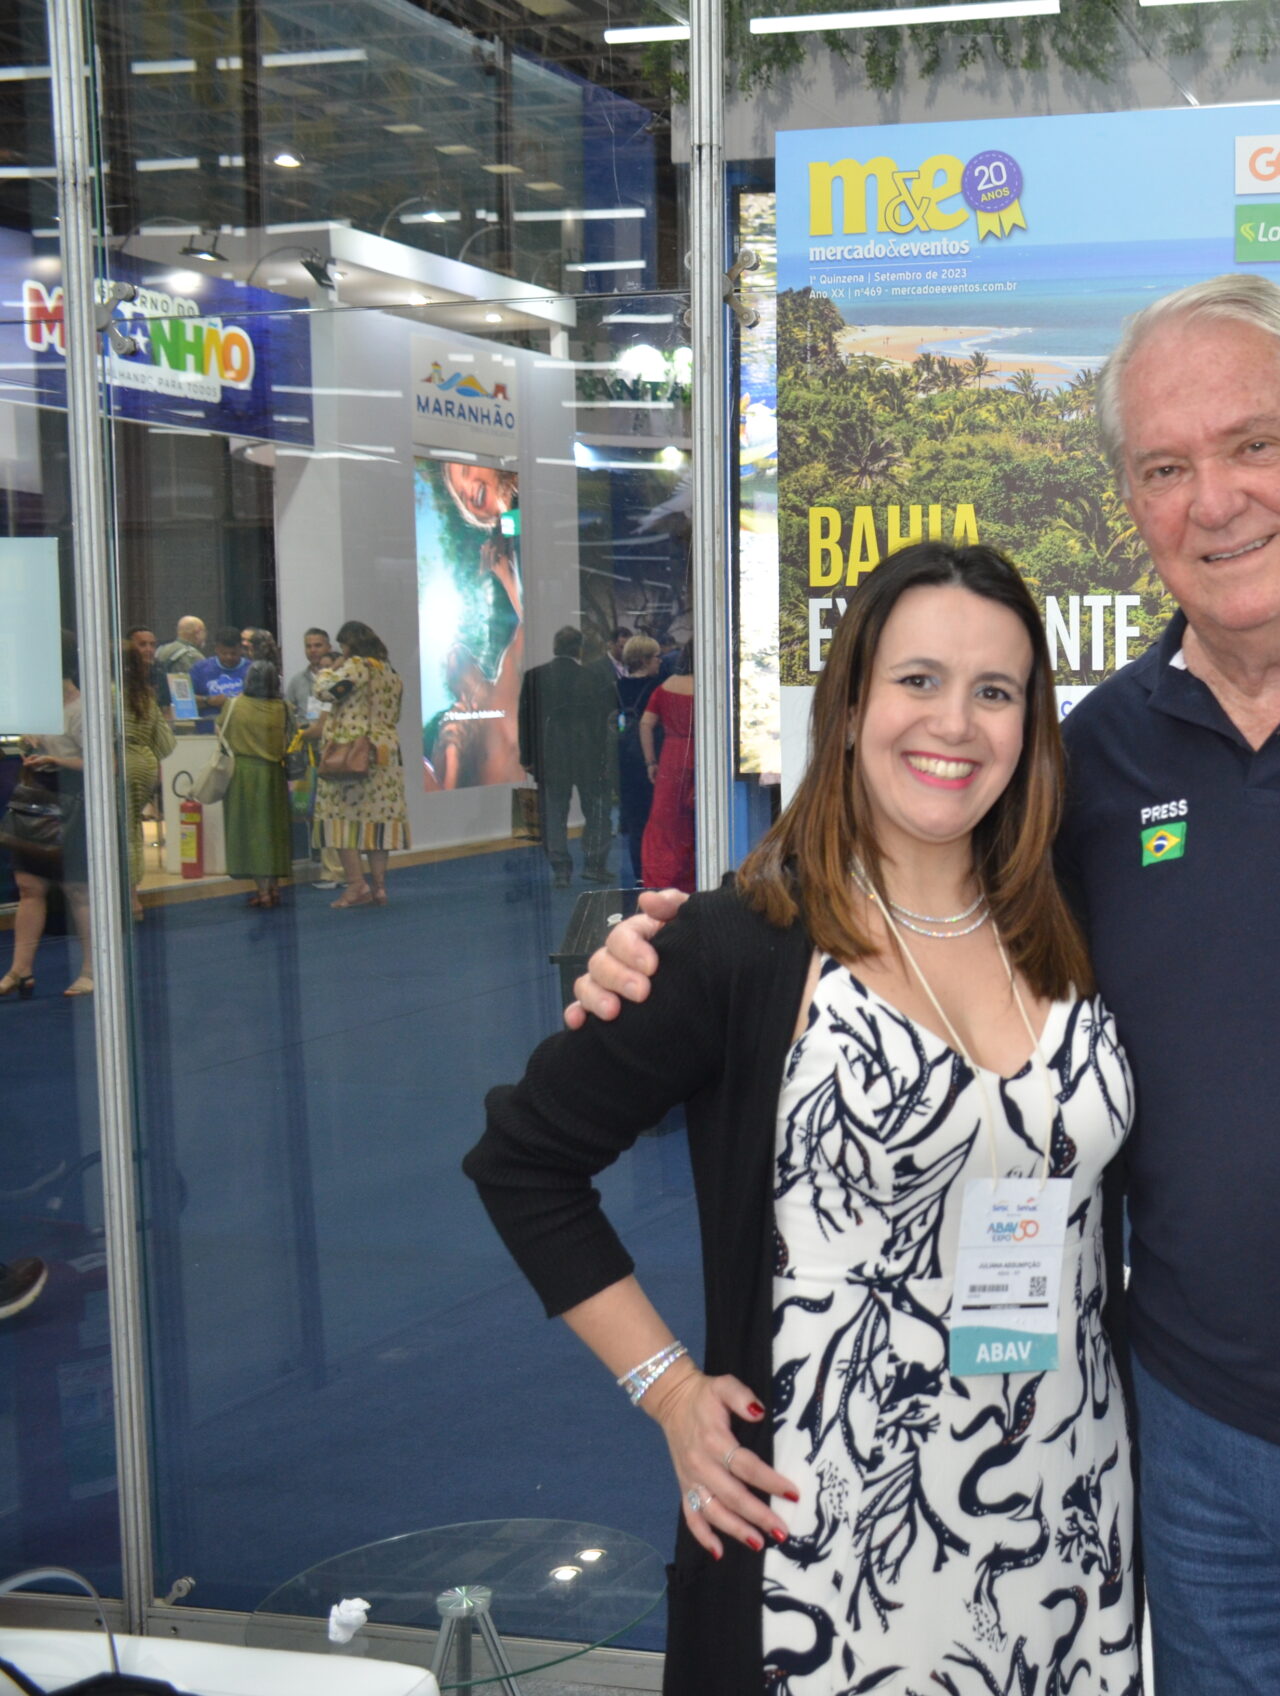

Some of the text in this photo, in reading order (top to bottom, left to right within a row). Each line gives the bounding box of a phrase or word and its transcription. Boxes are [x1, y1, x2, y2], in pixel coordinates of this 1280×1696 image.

[974, 161, 1008, 191] 20
[808, 154, 969, 236] m&e
[980, 187, 1010, 202] ANOS
[809, 238, 970, 262] mercado&eventos
[820, 274, 864, 284] Quinzena
[874, 271, 922, 282] Setembro
[926, 270, 937, 280] de
[941, 268, 967, 279] 2023
[809, 290, 828, 299] Ano
[831, 288, 845, 297] XX
[416, 394, 515, 430] MARANHÃO
[1141, 799, 1188, 825] PRESS
[992, 1234, 1011, 1242] EXPO
[976, 1340, 1032, 1363] ABAV
